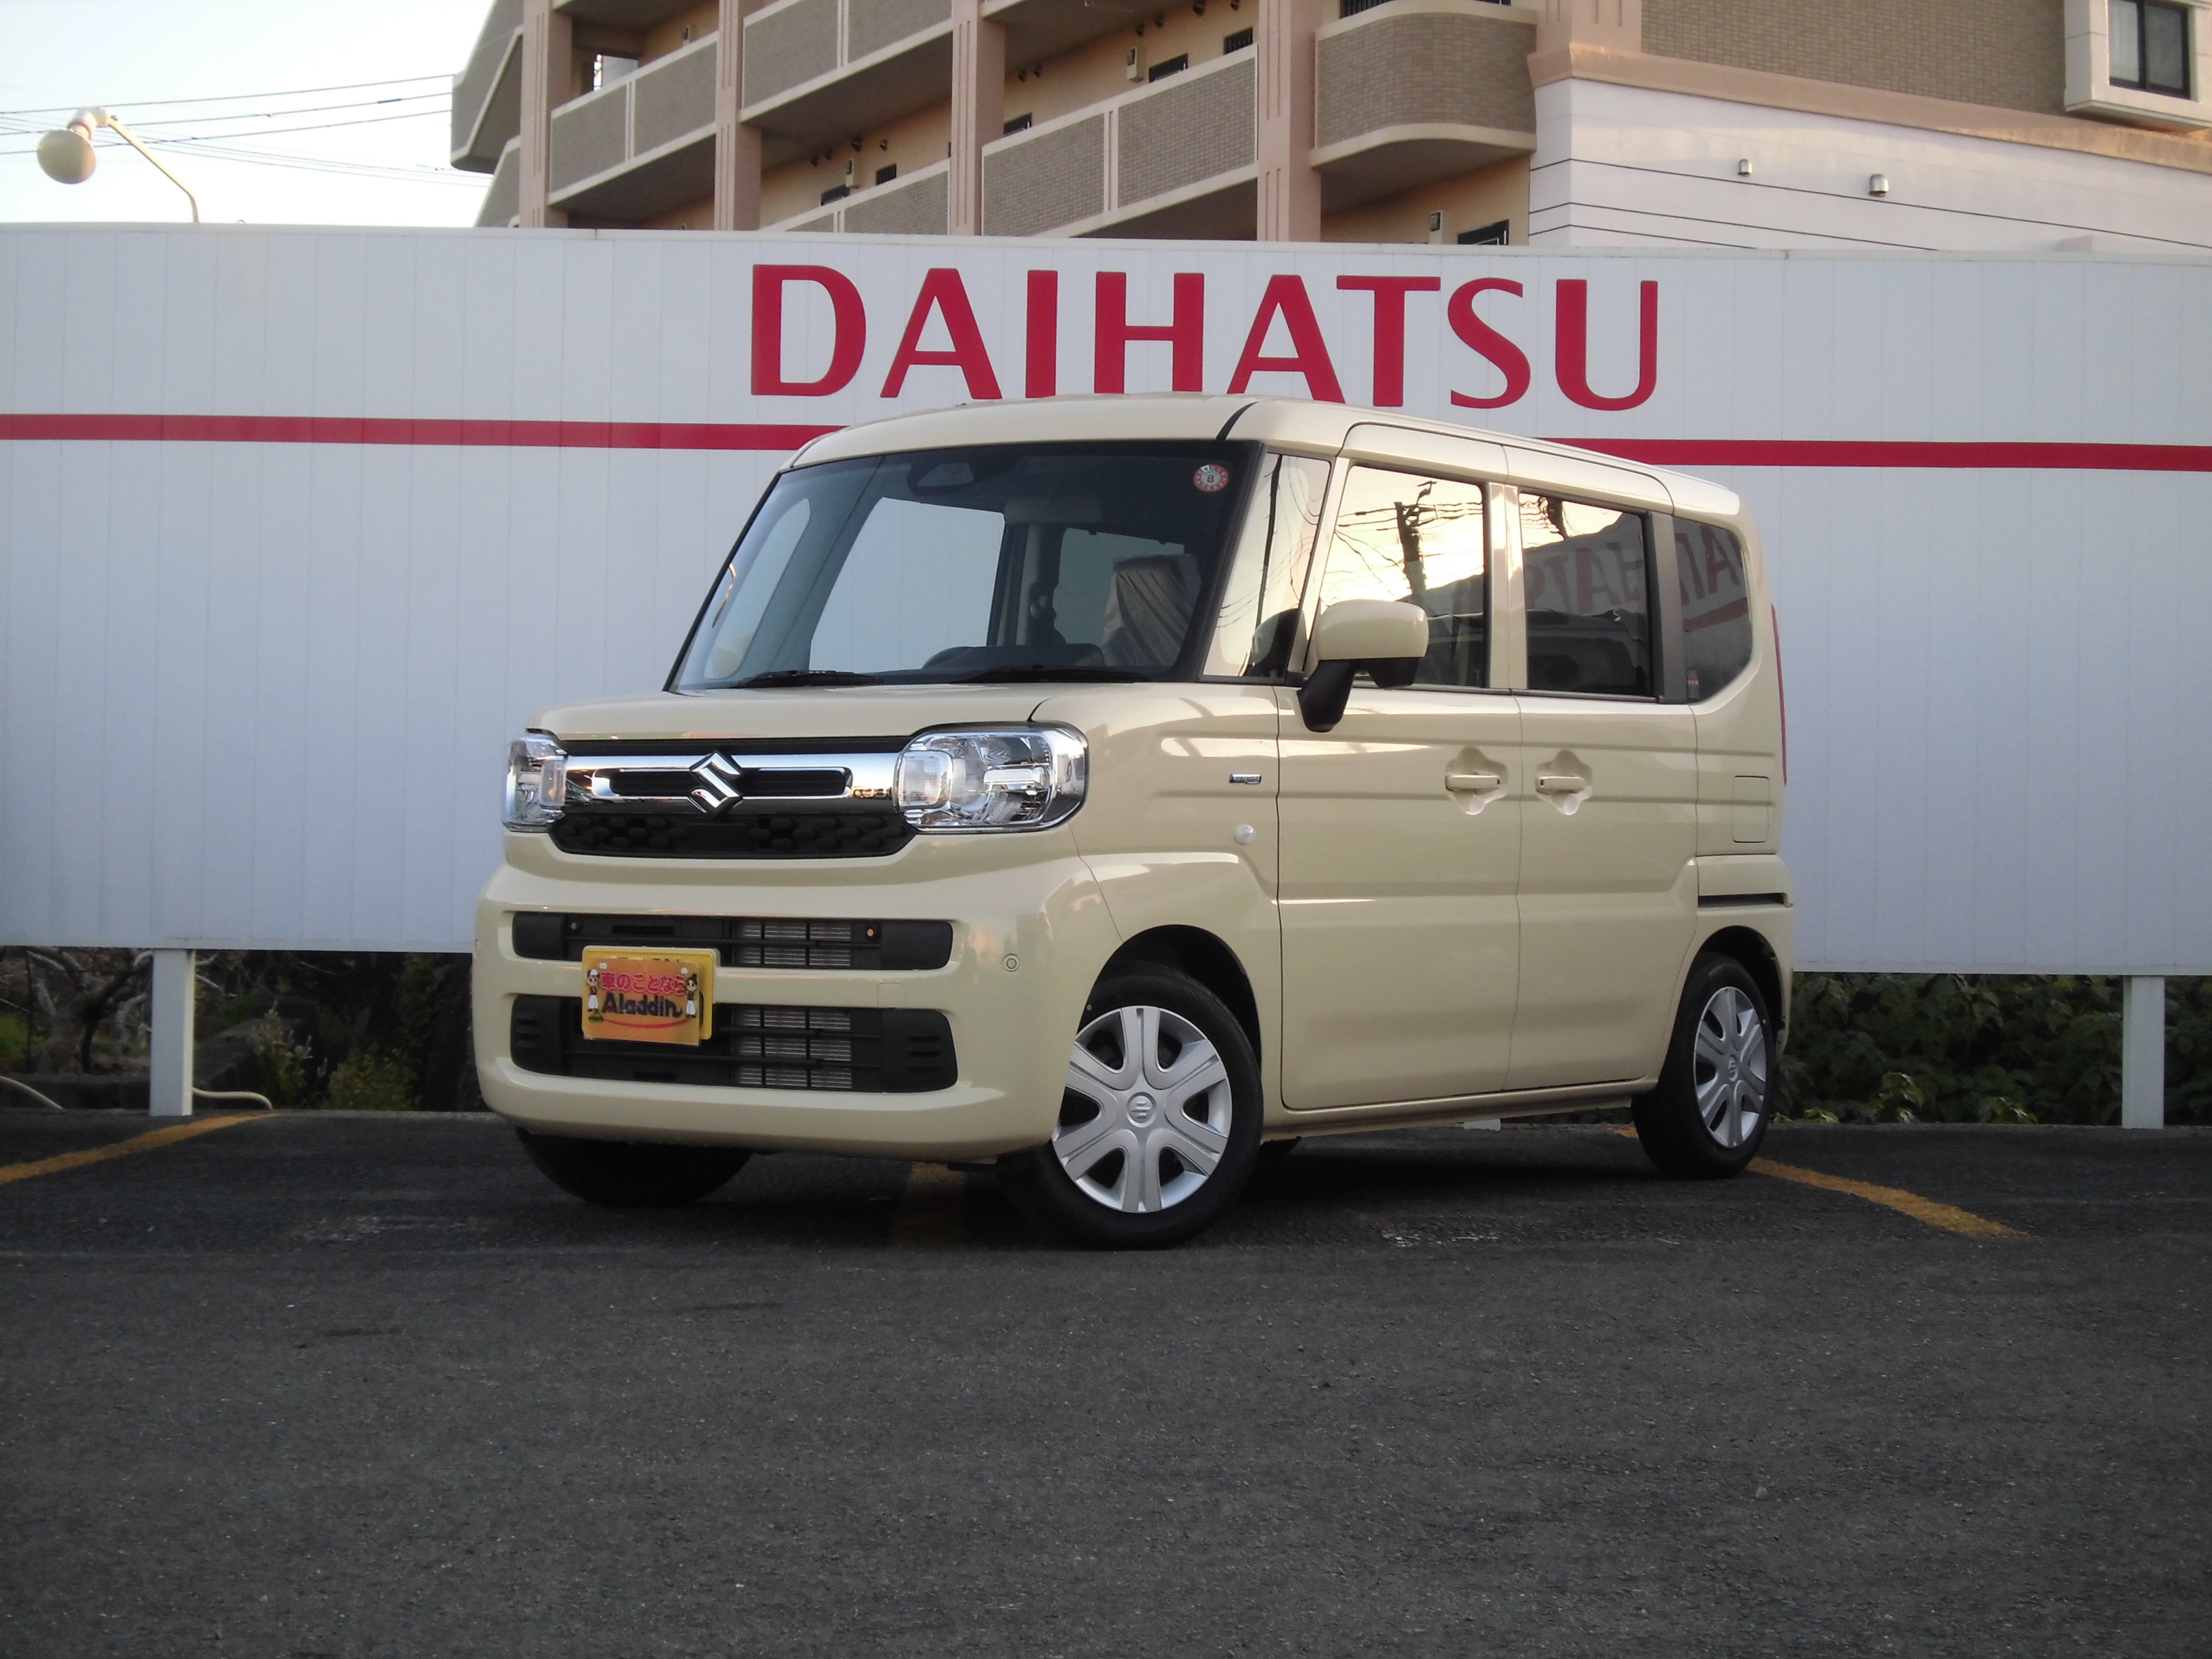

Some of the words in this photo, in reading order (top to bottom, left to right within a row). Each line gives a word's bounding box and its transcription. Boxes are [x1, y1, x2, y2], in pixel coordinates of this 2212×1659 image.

[751, 265, 1658, 410] DAIHATSU
[601, 971, 686, 996] 車のことなら
[602, 993, 683, 1018] Aladdin
